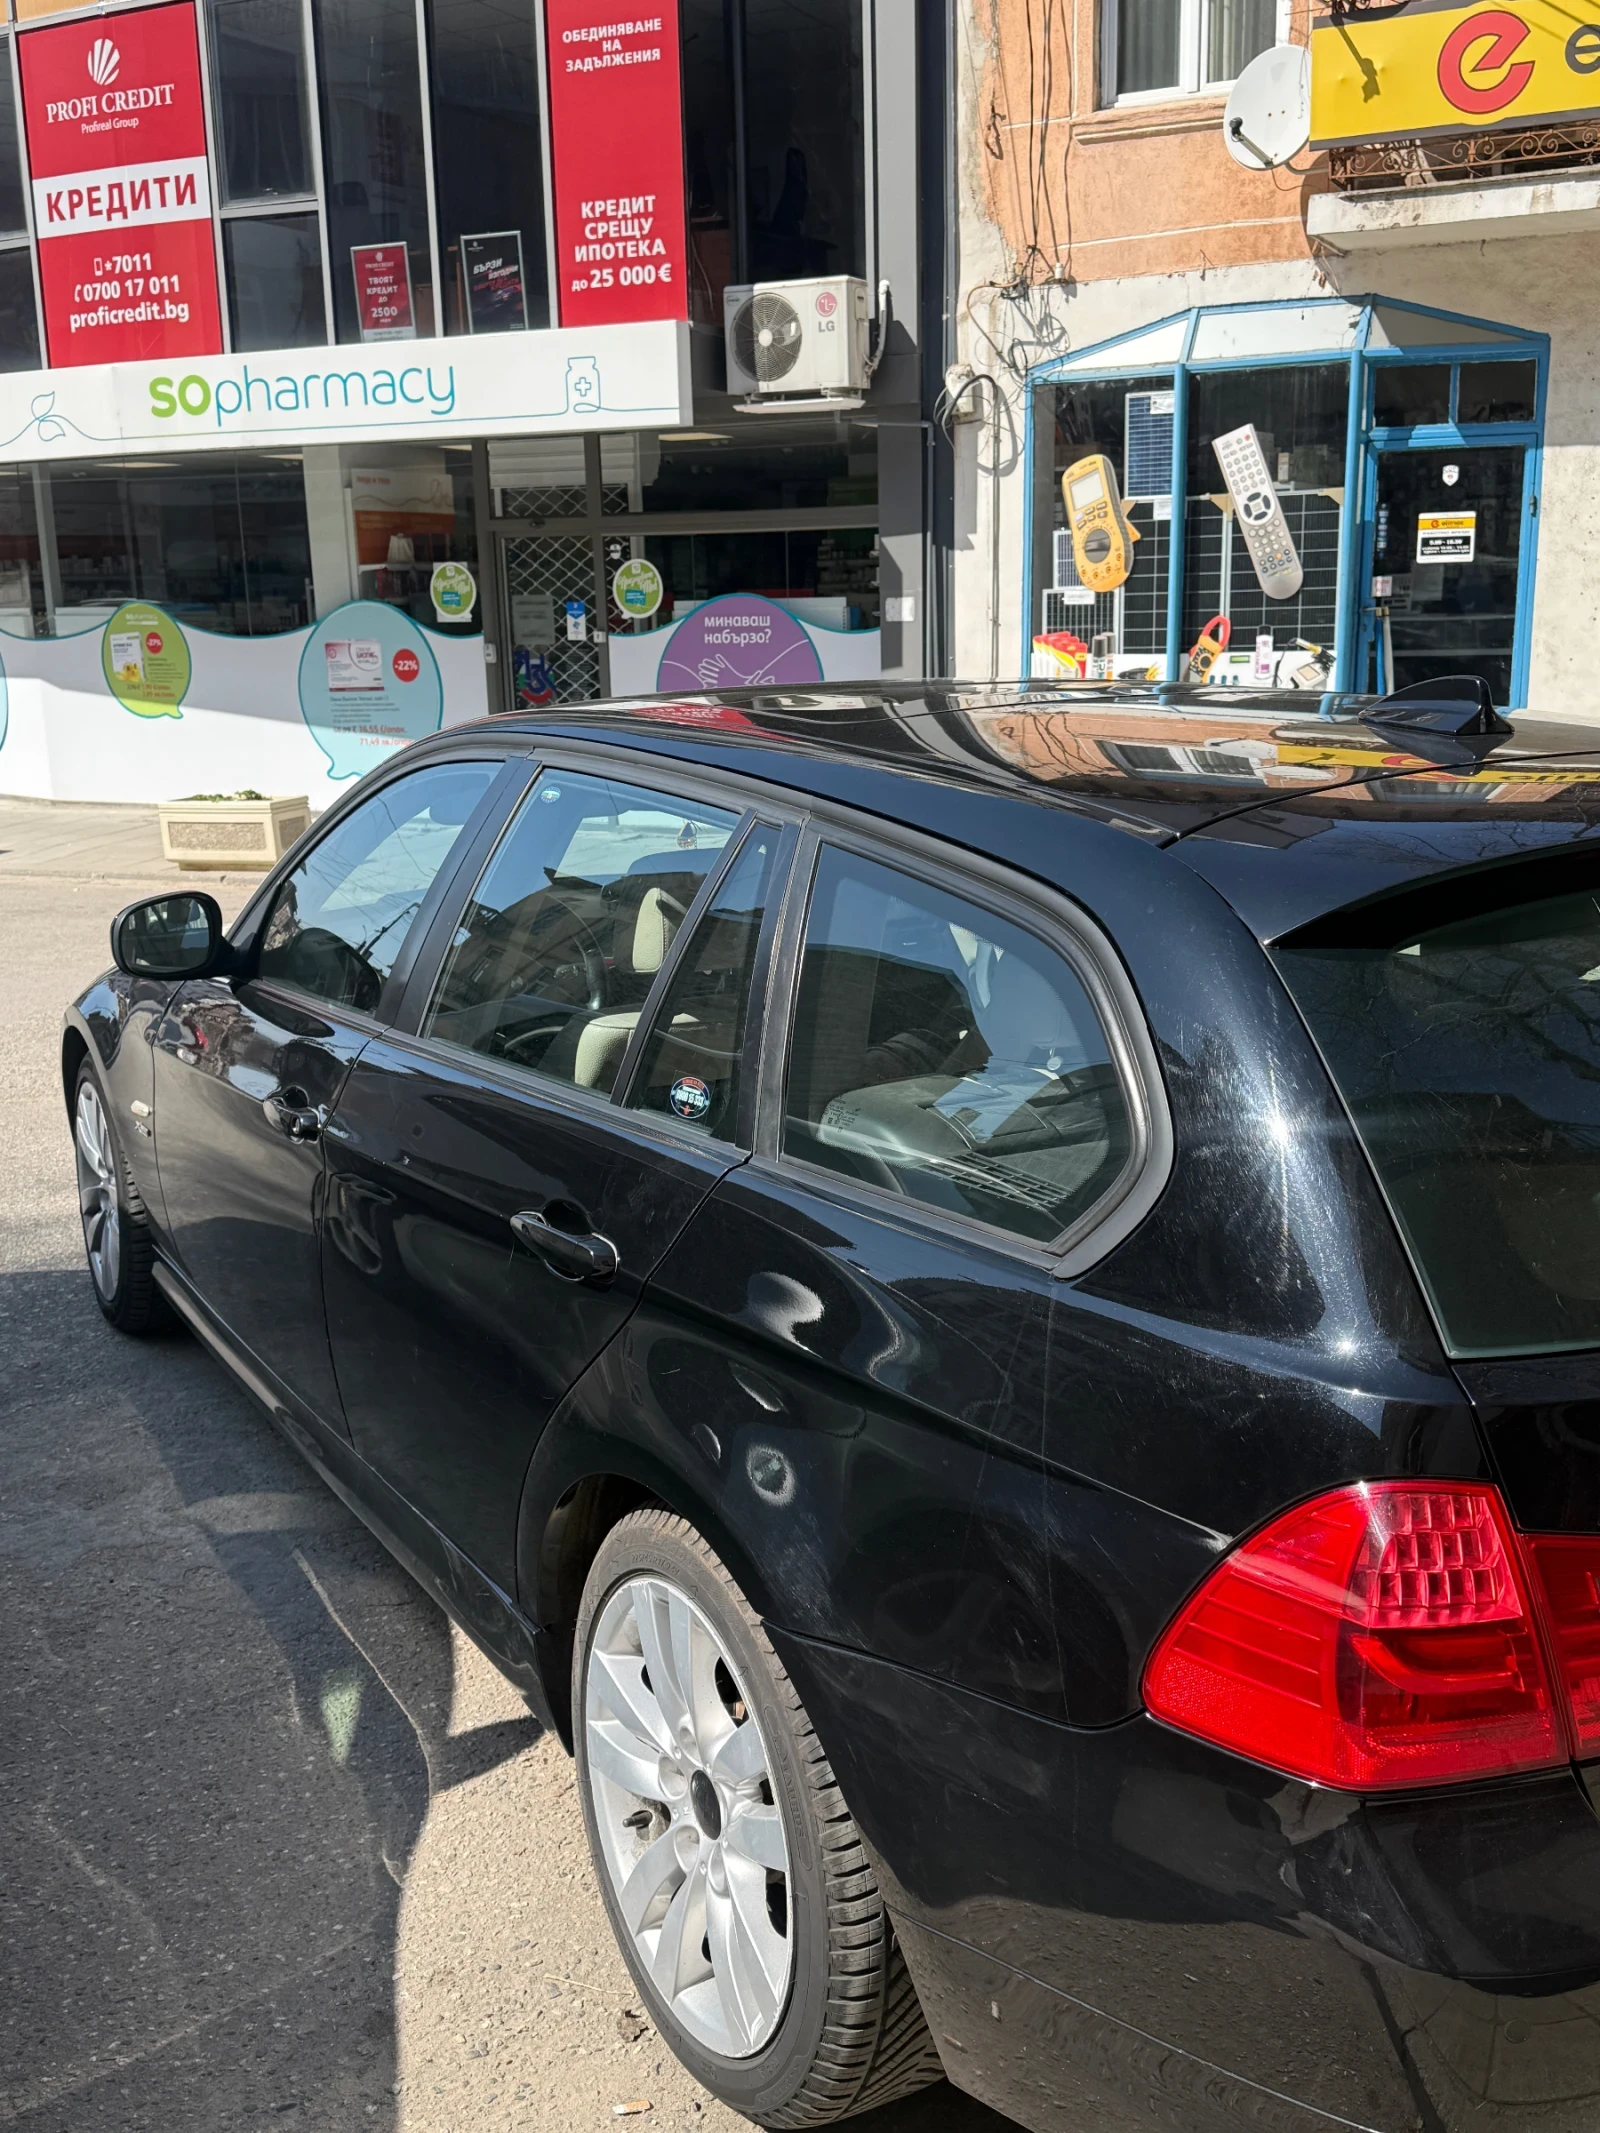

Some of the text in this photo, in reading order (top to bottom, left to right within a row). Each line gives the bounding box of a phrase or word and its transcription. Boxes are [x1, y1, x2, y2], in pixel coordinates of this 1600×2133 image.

[562, 18, 662, 44] ОБЕДИНЯВАНЕ
[602, 39, 622, 53] НА
[565, 48, 661, 73] ЗАДЪЛЖЕНИЯ
[46, 84, 175, 124] PROFI CREDIT
[81, 117, 139, 134] Profireal Group
[46, 173, 197, 223] КРЕДИТИ
[581, 195, 656, 219] КРЕДИТ
[584, 217, 653, 240] СРЕЩУ
[574, 238, 667, 263] ИПОТЕКА
[83, 274, 180, 302] 0700 17 011
[366, 285, 398, 295] КРЕДИТ
[368, 276, 394, 285] ТВОЯТ
[571, 279, 588, 292] до
[590, 268, 614, 288] 25
[69, 299, 189, 334] proficredit.bg
[371, 306, 398, 318] 2500
[818, 320, 836, 333] LG
[149, 364, 456, 428] sopharmacy
[704, 615, 771, 628] минаваш
[704, 628, 772, 648] набързо?
[394, 660, 418, 671] -22%
